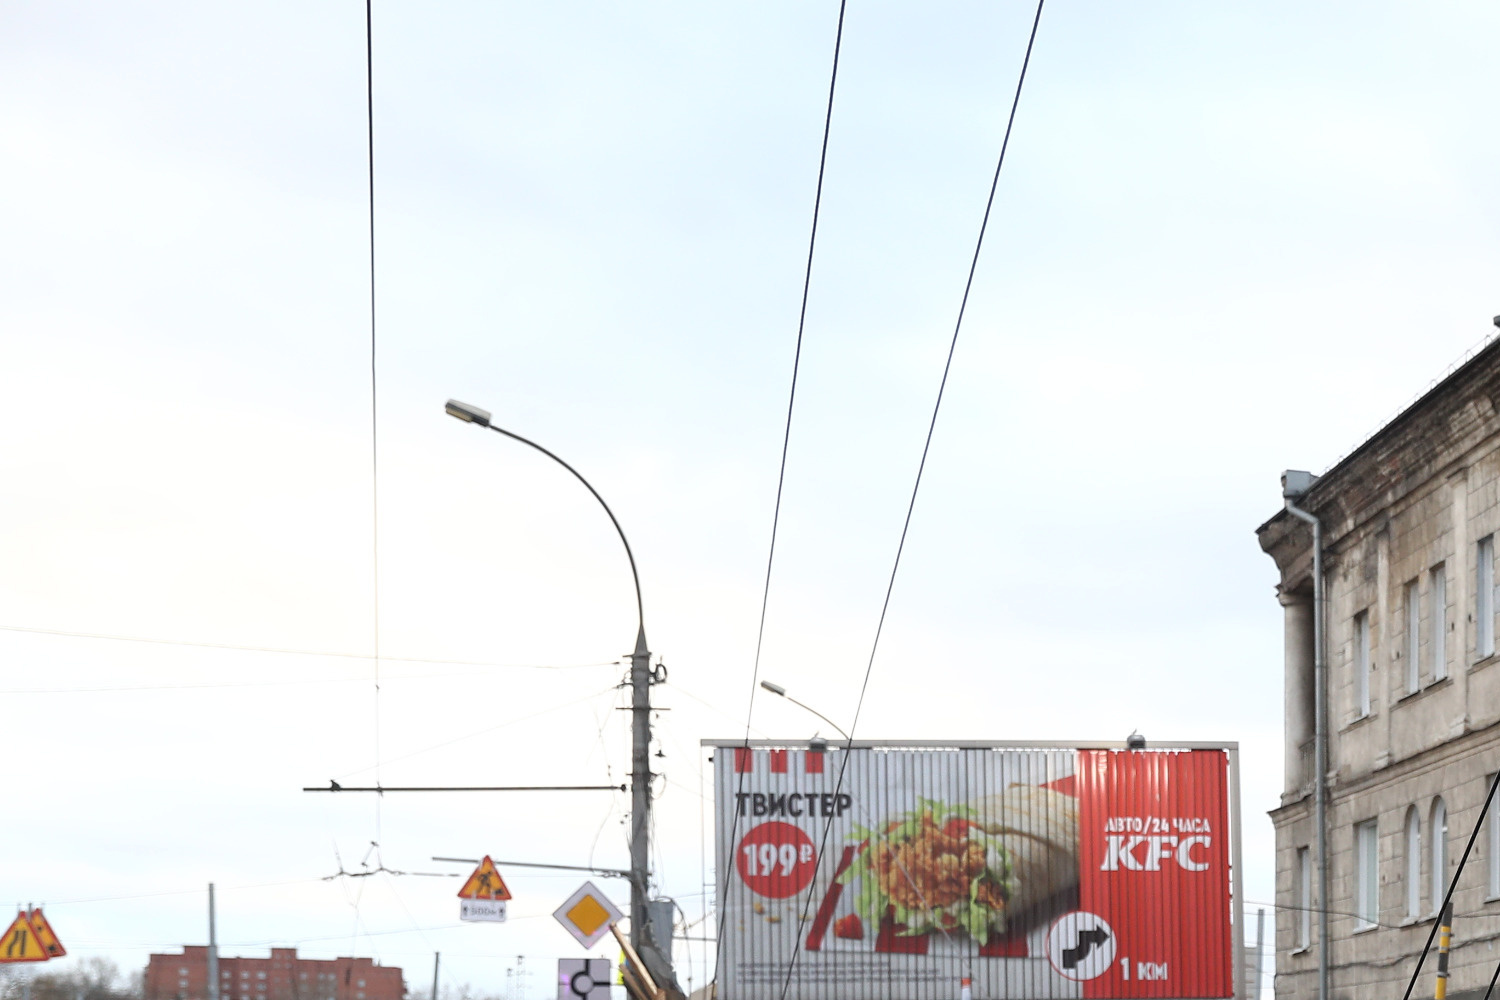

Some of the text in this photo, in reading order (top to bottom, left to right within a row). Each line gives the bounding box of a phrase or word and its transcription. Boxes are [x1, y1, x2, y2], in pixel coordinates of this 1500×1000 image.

[735, 792, 853, 818] ТВИСТЕР
[1104, 816, 1212, 834] АВТО/24 ЧАСА
[1100, 835, 1212, 872] KFC
[1120, 956, 1131, 981] 1
